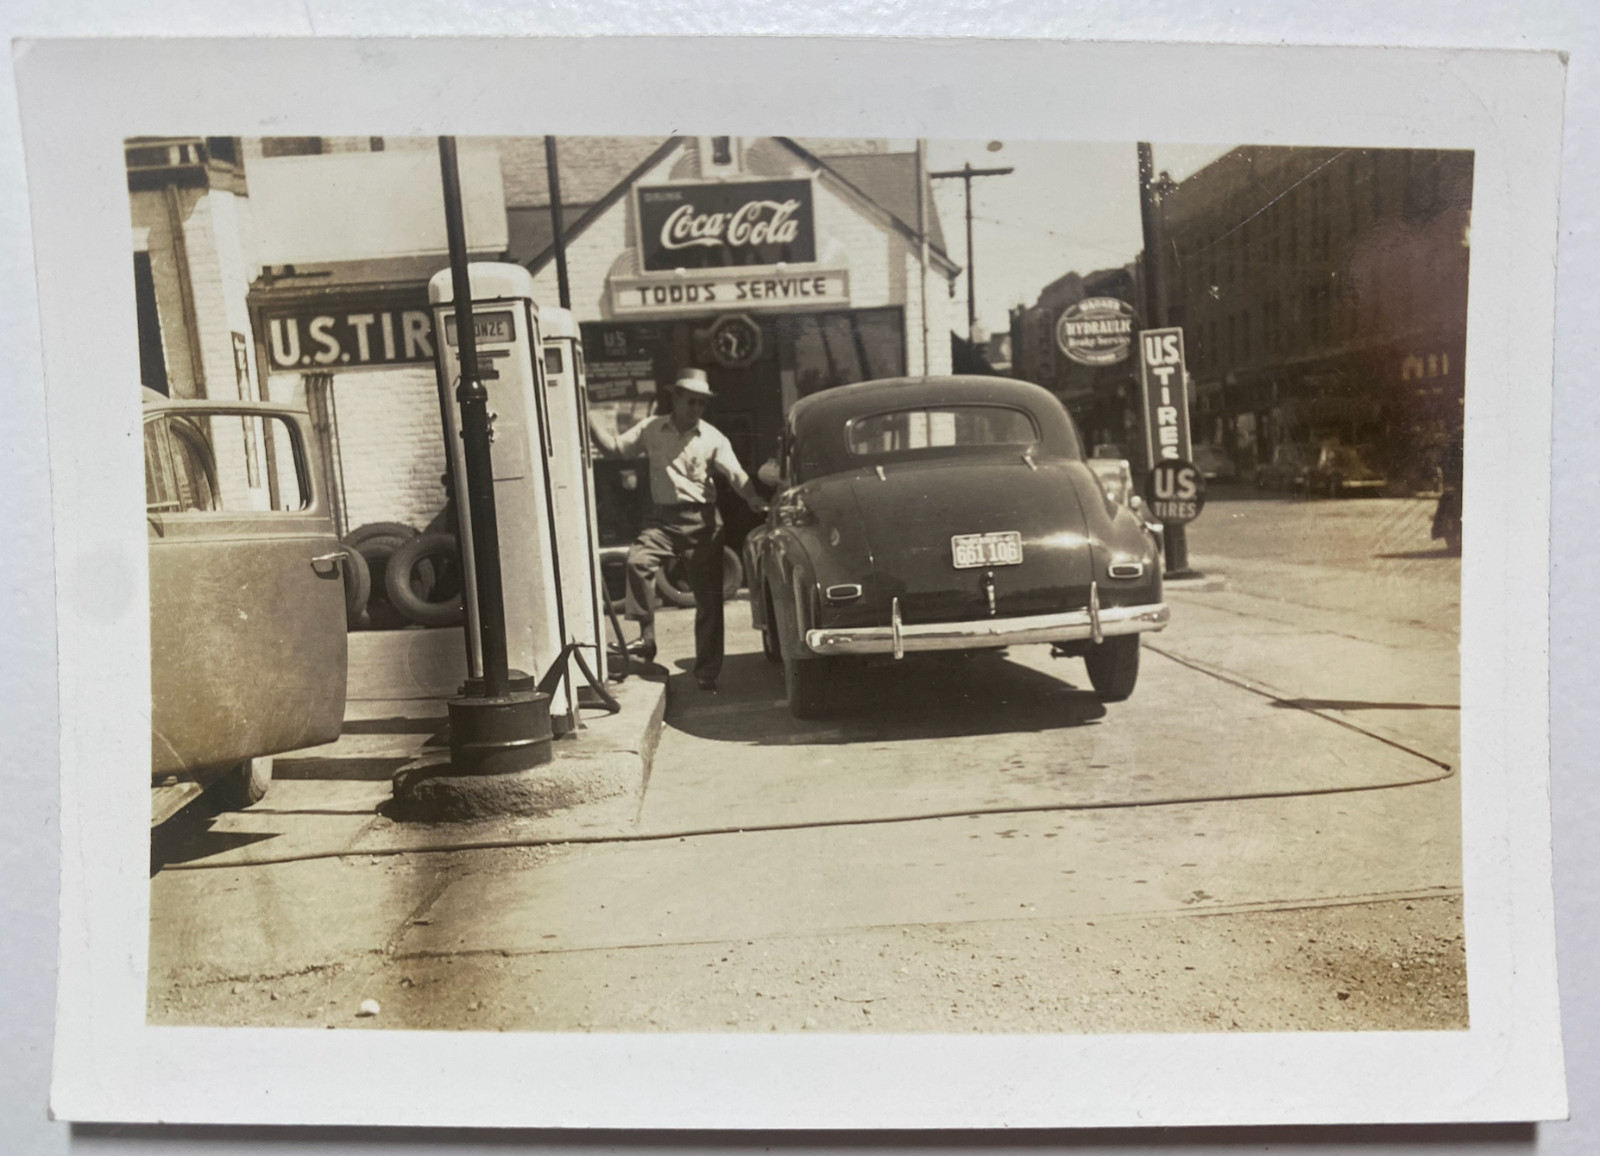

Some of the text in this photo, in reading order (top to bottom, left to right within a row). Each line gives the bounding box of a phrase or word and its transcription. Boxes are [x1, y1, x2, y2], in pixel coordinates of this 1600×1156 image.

[660, 199, 802, 249] Coca-Cola
[735, 277, 826, 299] SERVICE
[347, 310, 433, 362] TIR
[474, 320, 504, 337] ONZE
[1154, 502, 1197, 518] TIRES
